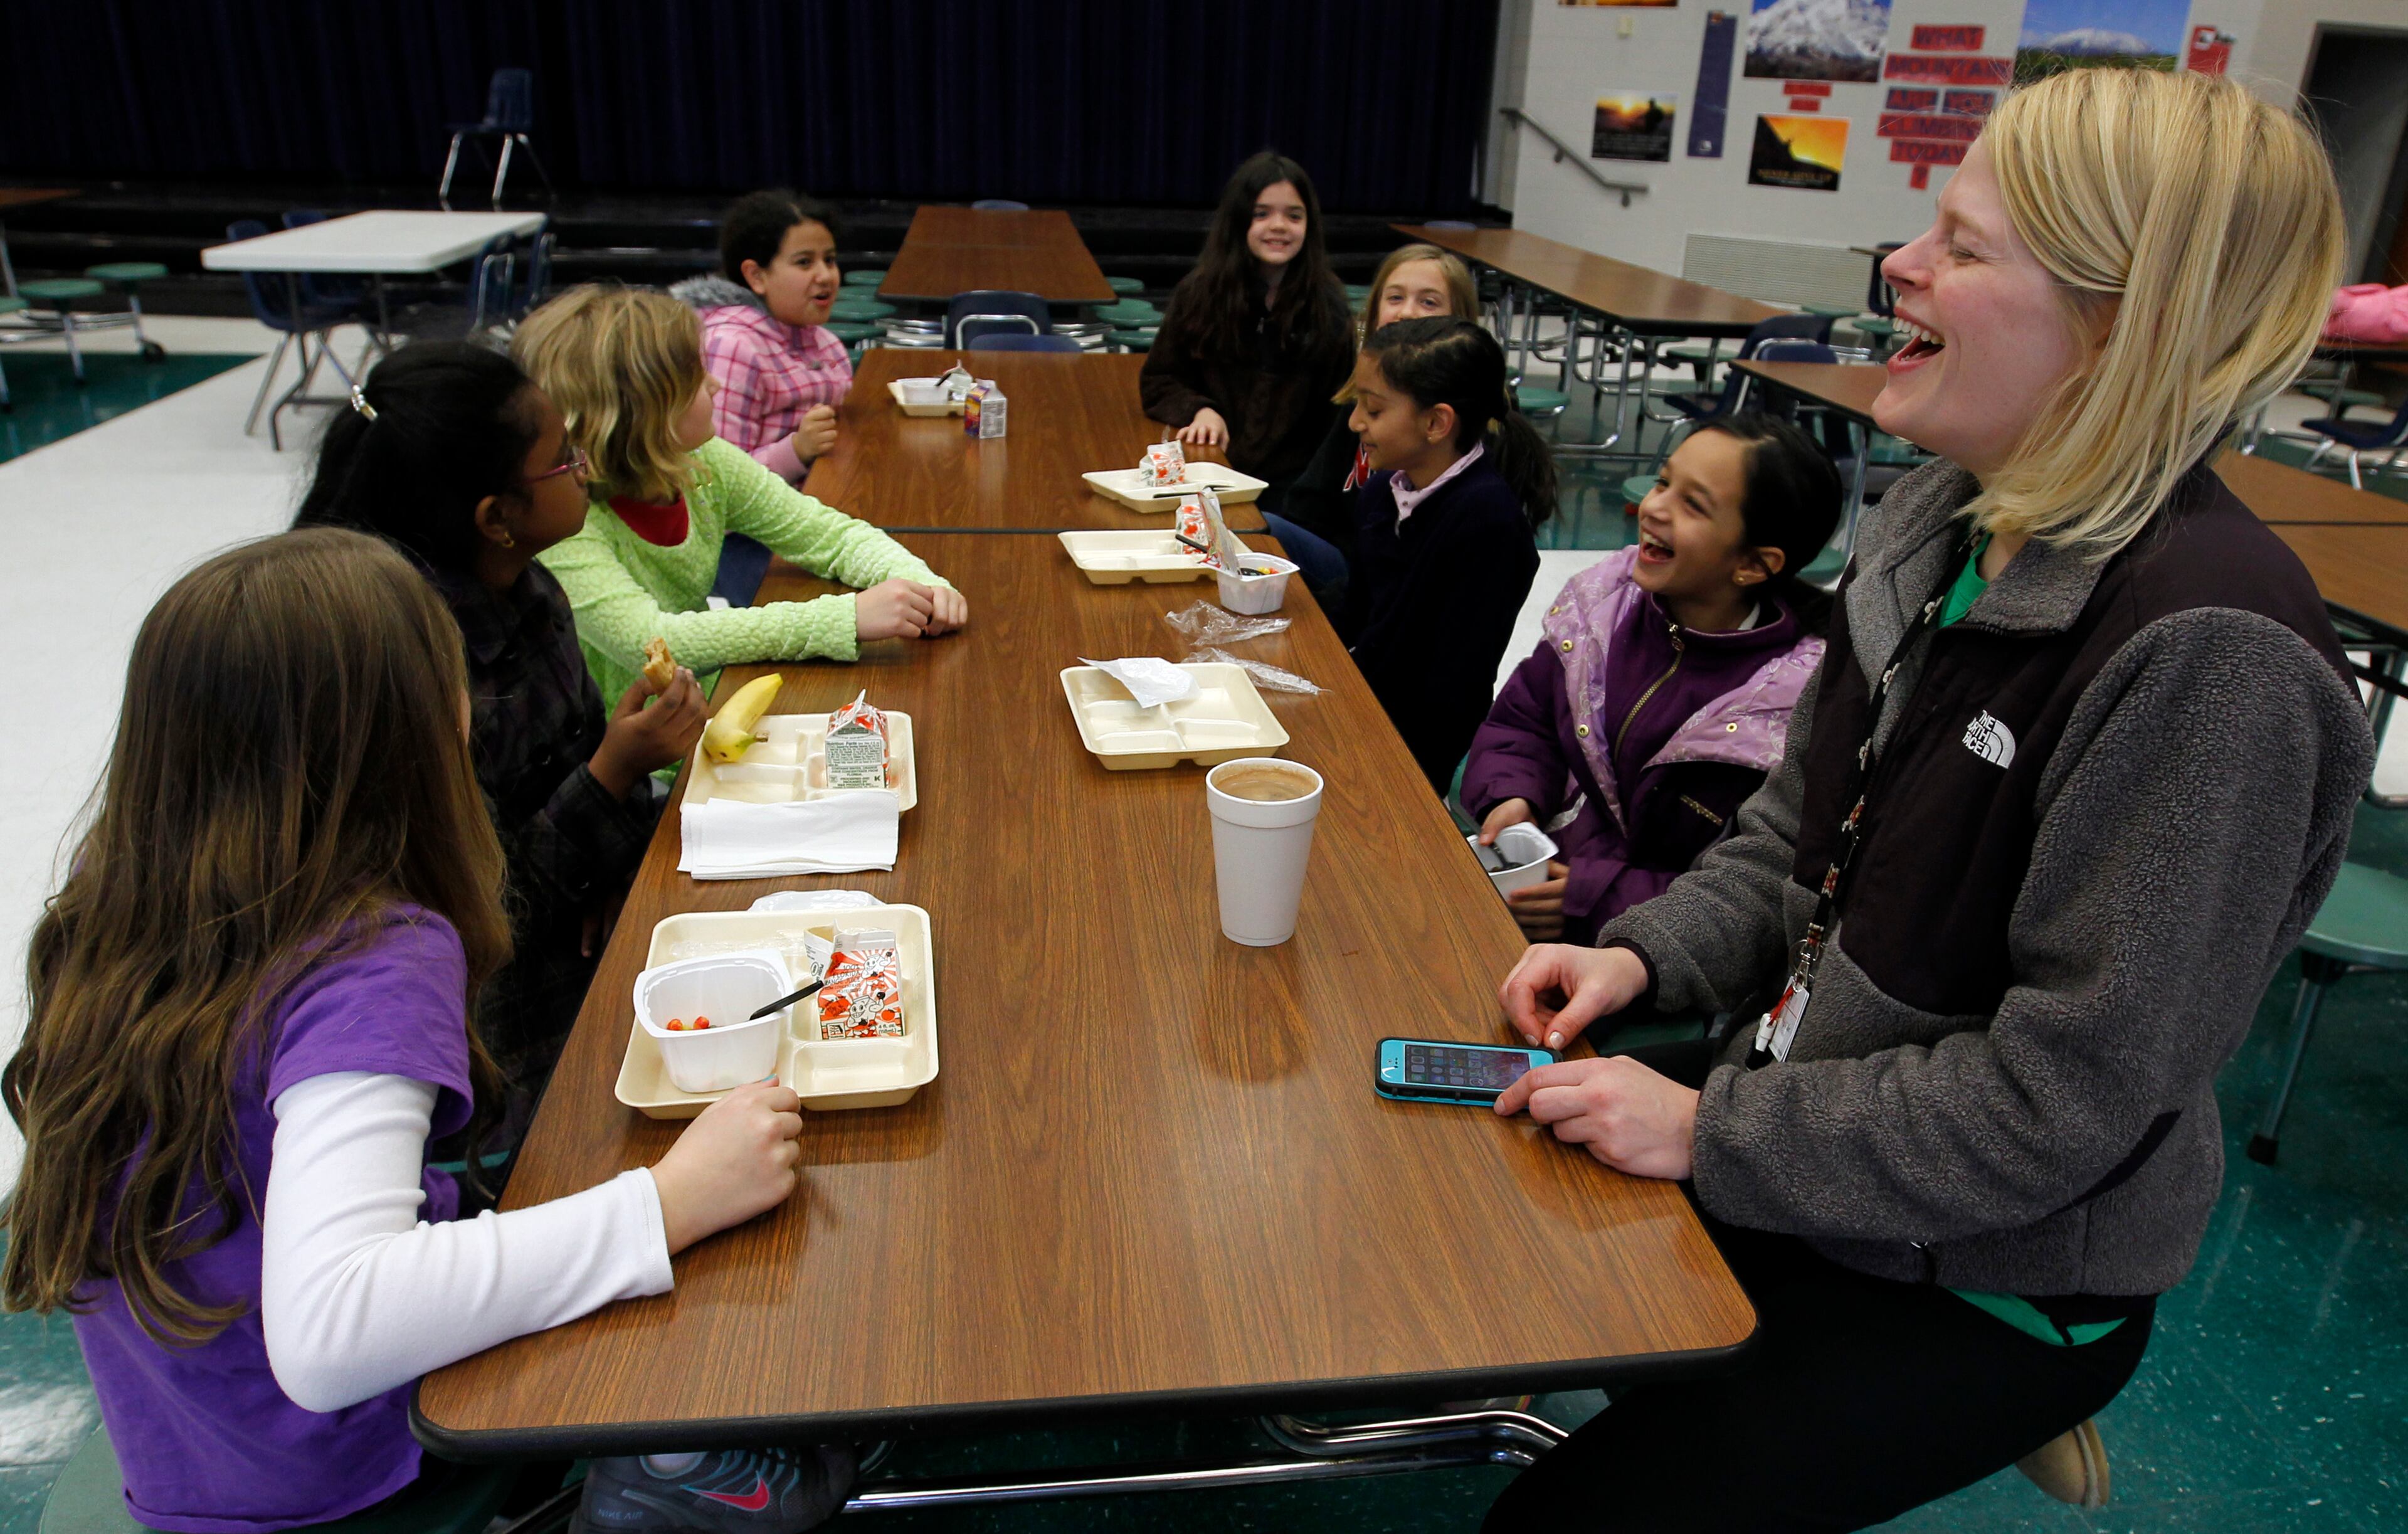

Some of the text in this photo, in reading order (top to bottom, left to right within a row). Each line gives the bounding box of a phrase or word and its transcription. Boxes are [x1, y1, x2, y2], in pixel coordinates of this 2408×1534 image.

[1915, 27, 1980, 46] WHAT
[1889, 90, 1993, 112] ARE YOU
[1978, 709, 1996, 731] THE
[1962, 731, 1984, 755] FACE
[833, 970, 860, 979] FLORIDA
[598, 1509, 622, 1520] NIKE
